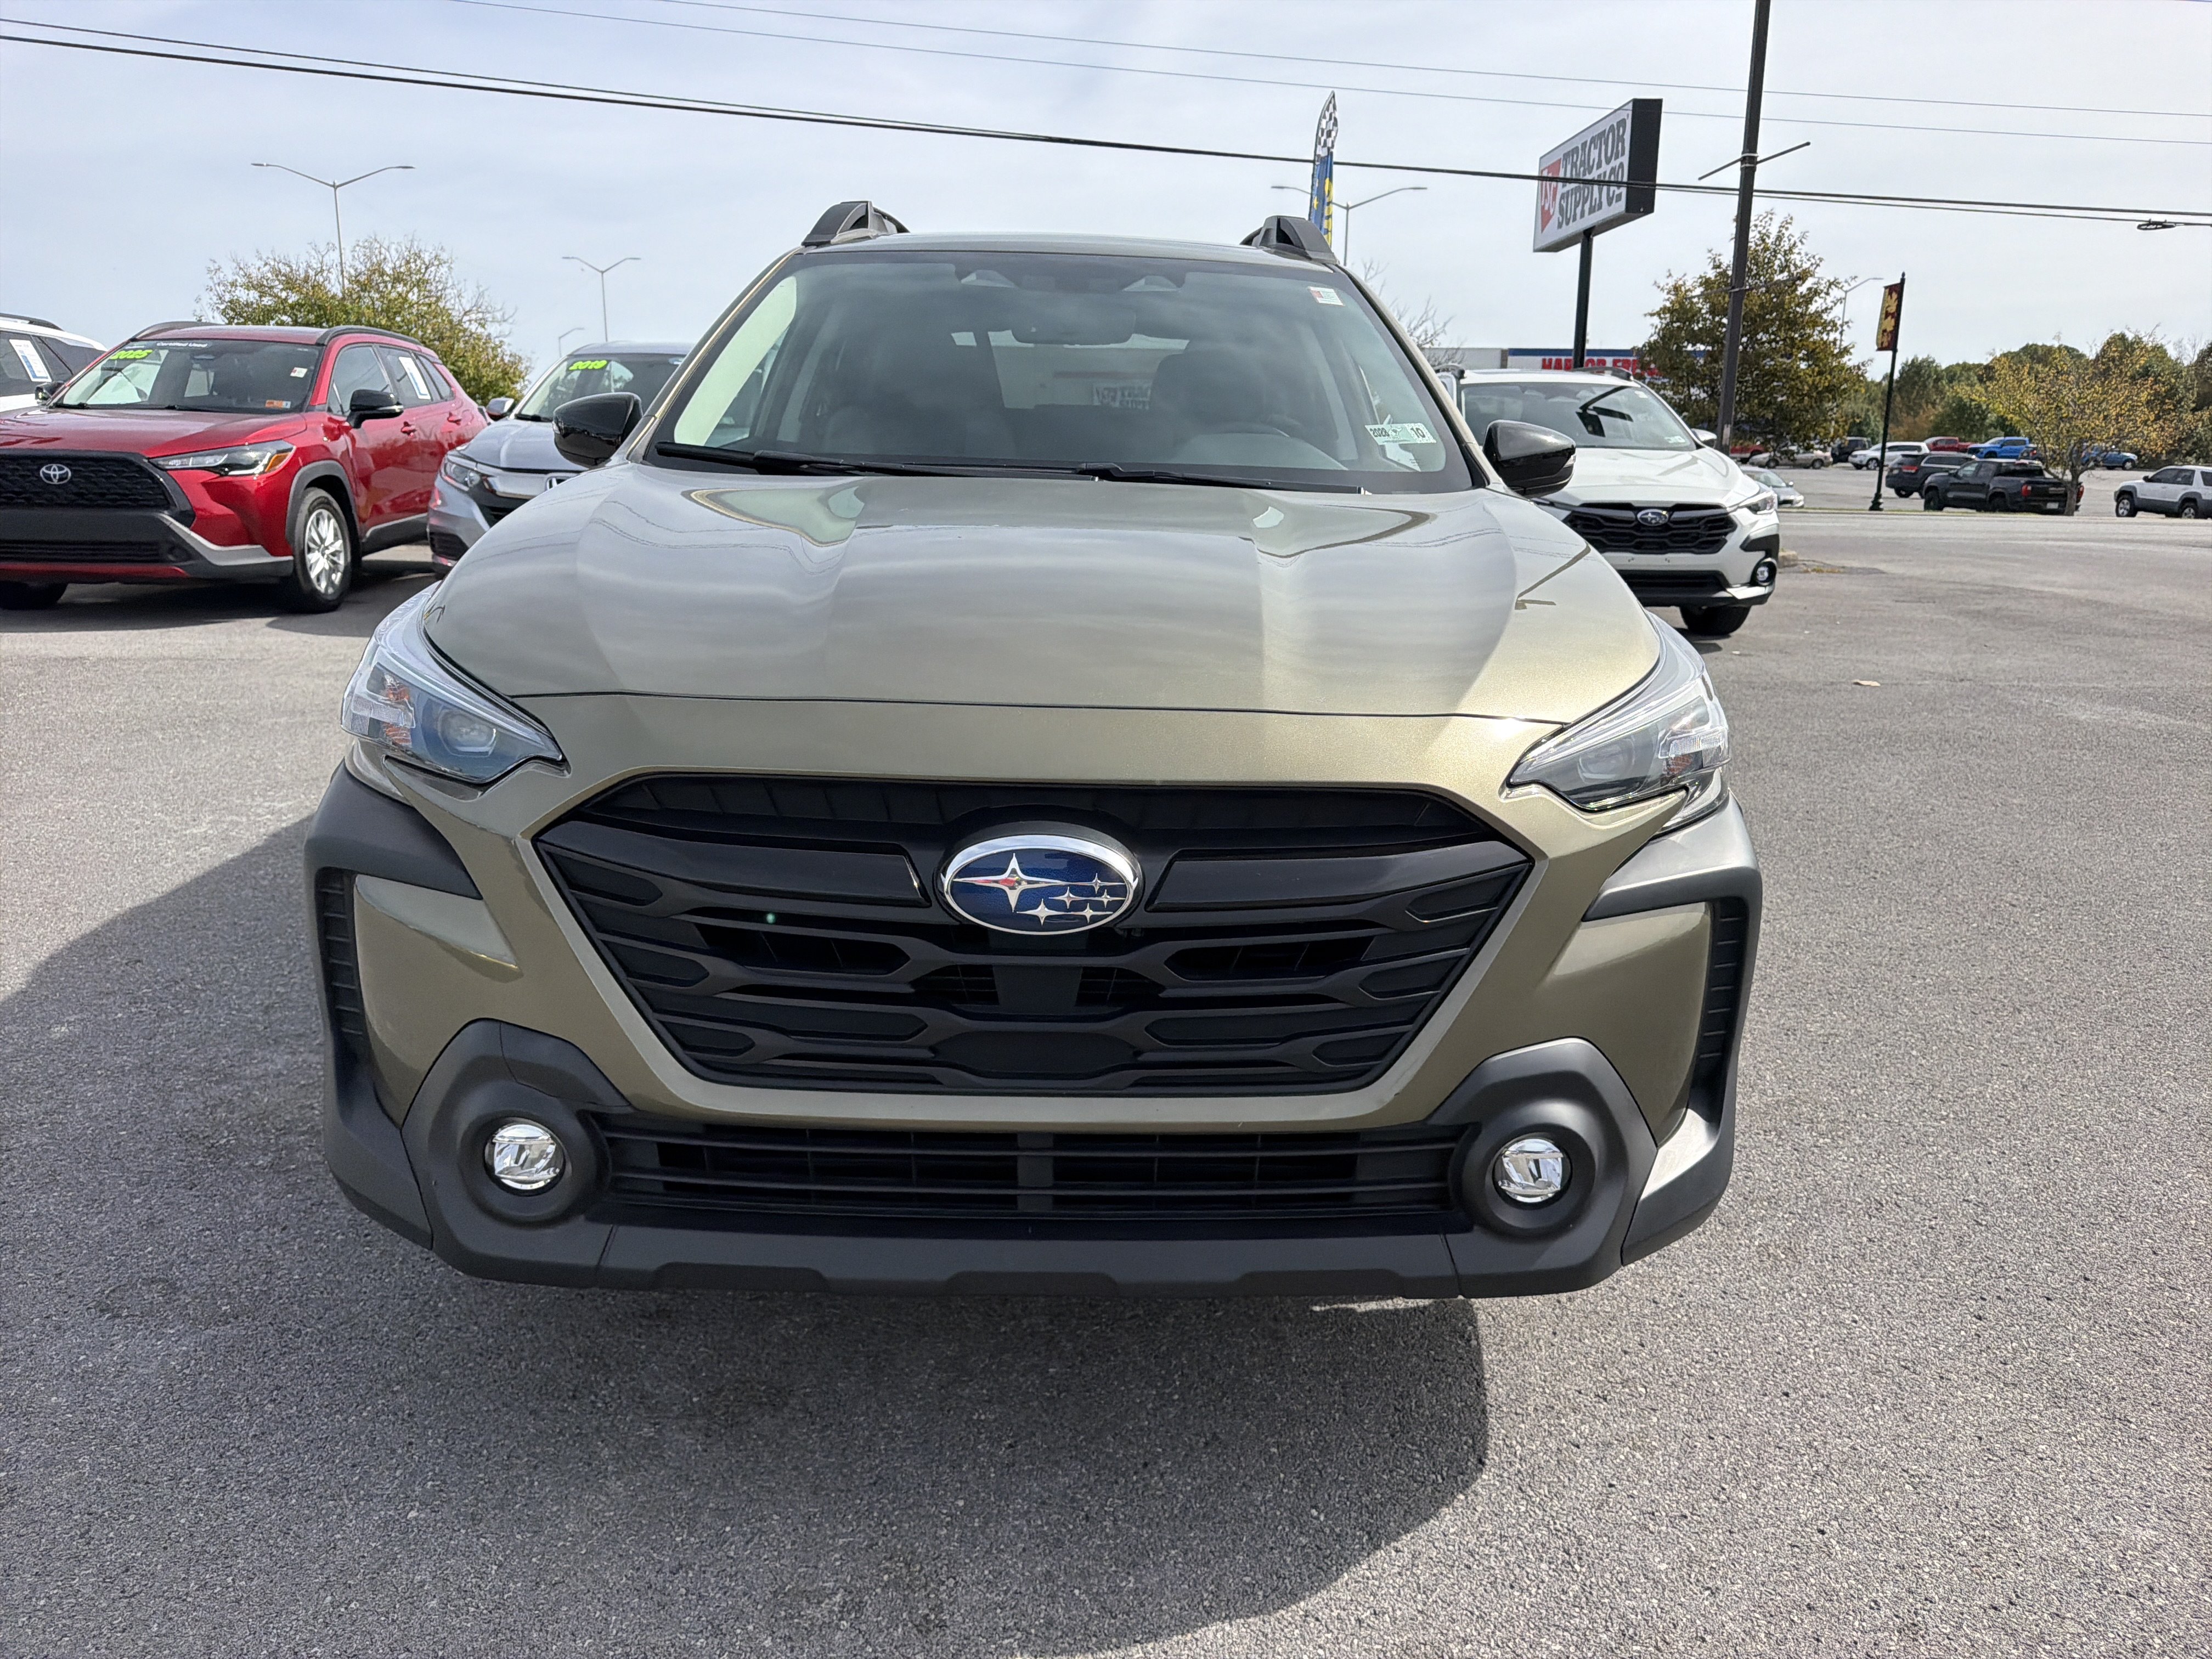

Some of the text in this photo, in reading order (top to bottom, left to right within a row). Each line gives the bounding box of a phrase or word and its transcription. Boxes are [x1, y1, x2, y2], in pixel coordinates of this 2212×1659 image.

[1562, 117, 1627, 188] TRACTOR
[1556, 170, 1606, 230] SUPPLY
[1542, 357, 1607, 374] HAROR
[1410, 427, 1426, 438] 10
